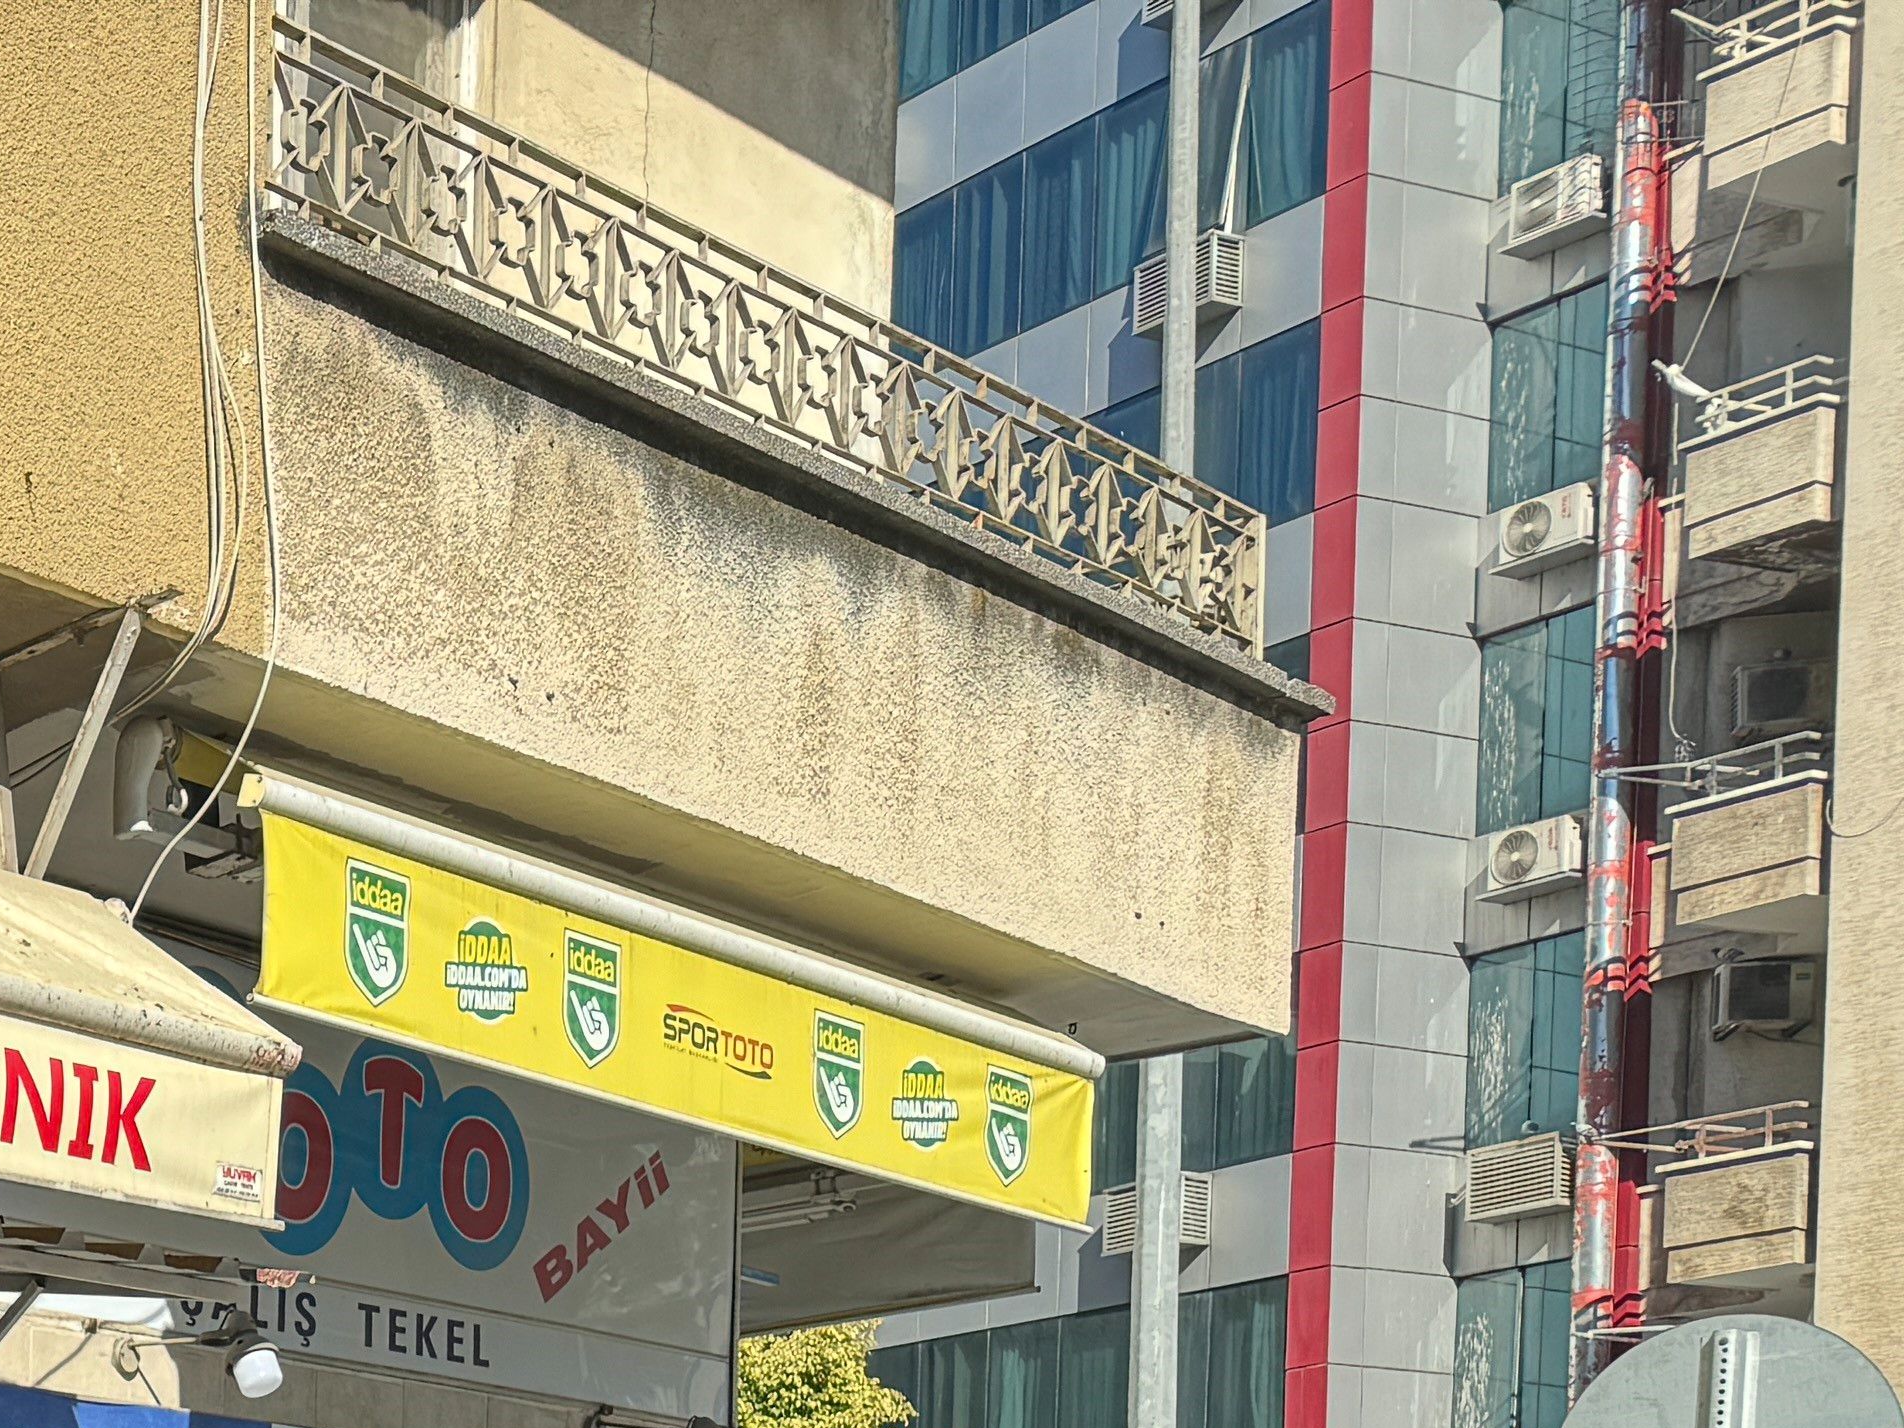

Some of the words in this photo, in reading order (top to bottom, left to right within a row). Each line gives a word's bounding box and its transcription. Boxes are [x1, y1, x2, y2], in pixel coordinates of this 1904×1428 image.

[351, 873, 404, 916] iddaa
[569, 942, 614, 982] iddaa
[819, 1023, 859, 1058] iddaa
[278, 1055, 512, 1242] OTO
[358, 1302, 490, 1367] TEKEL
